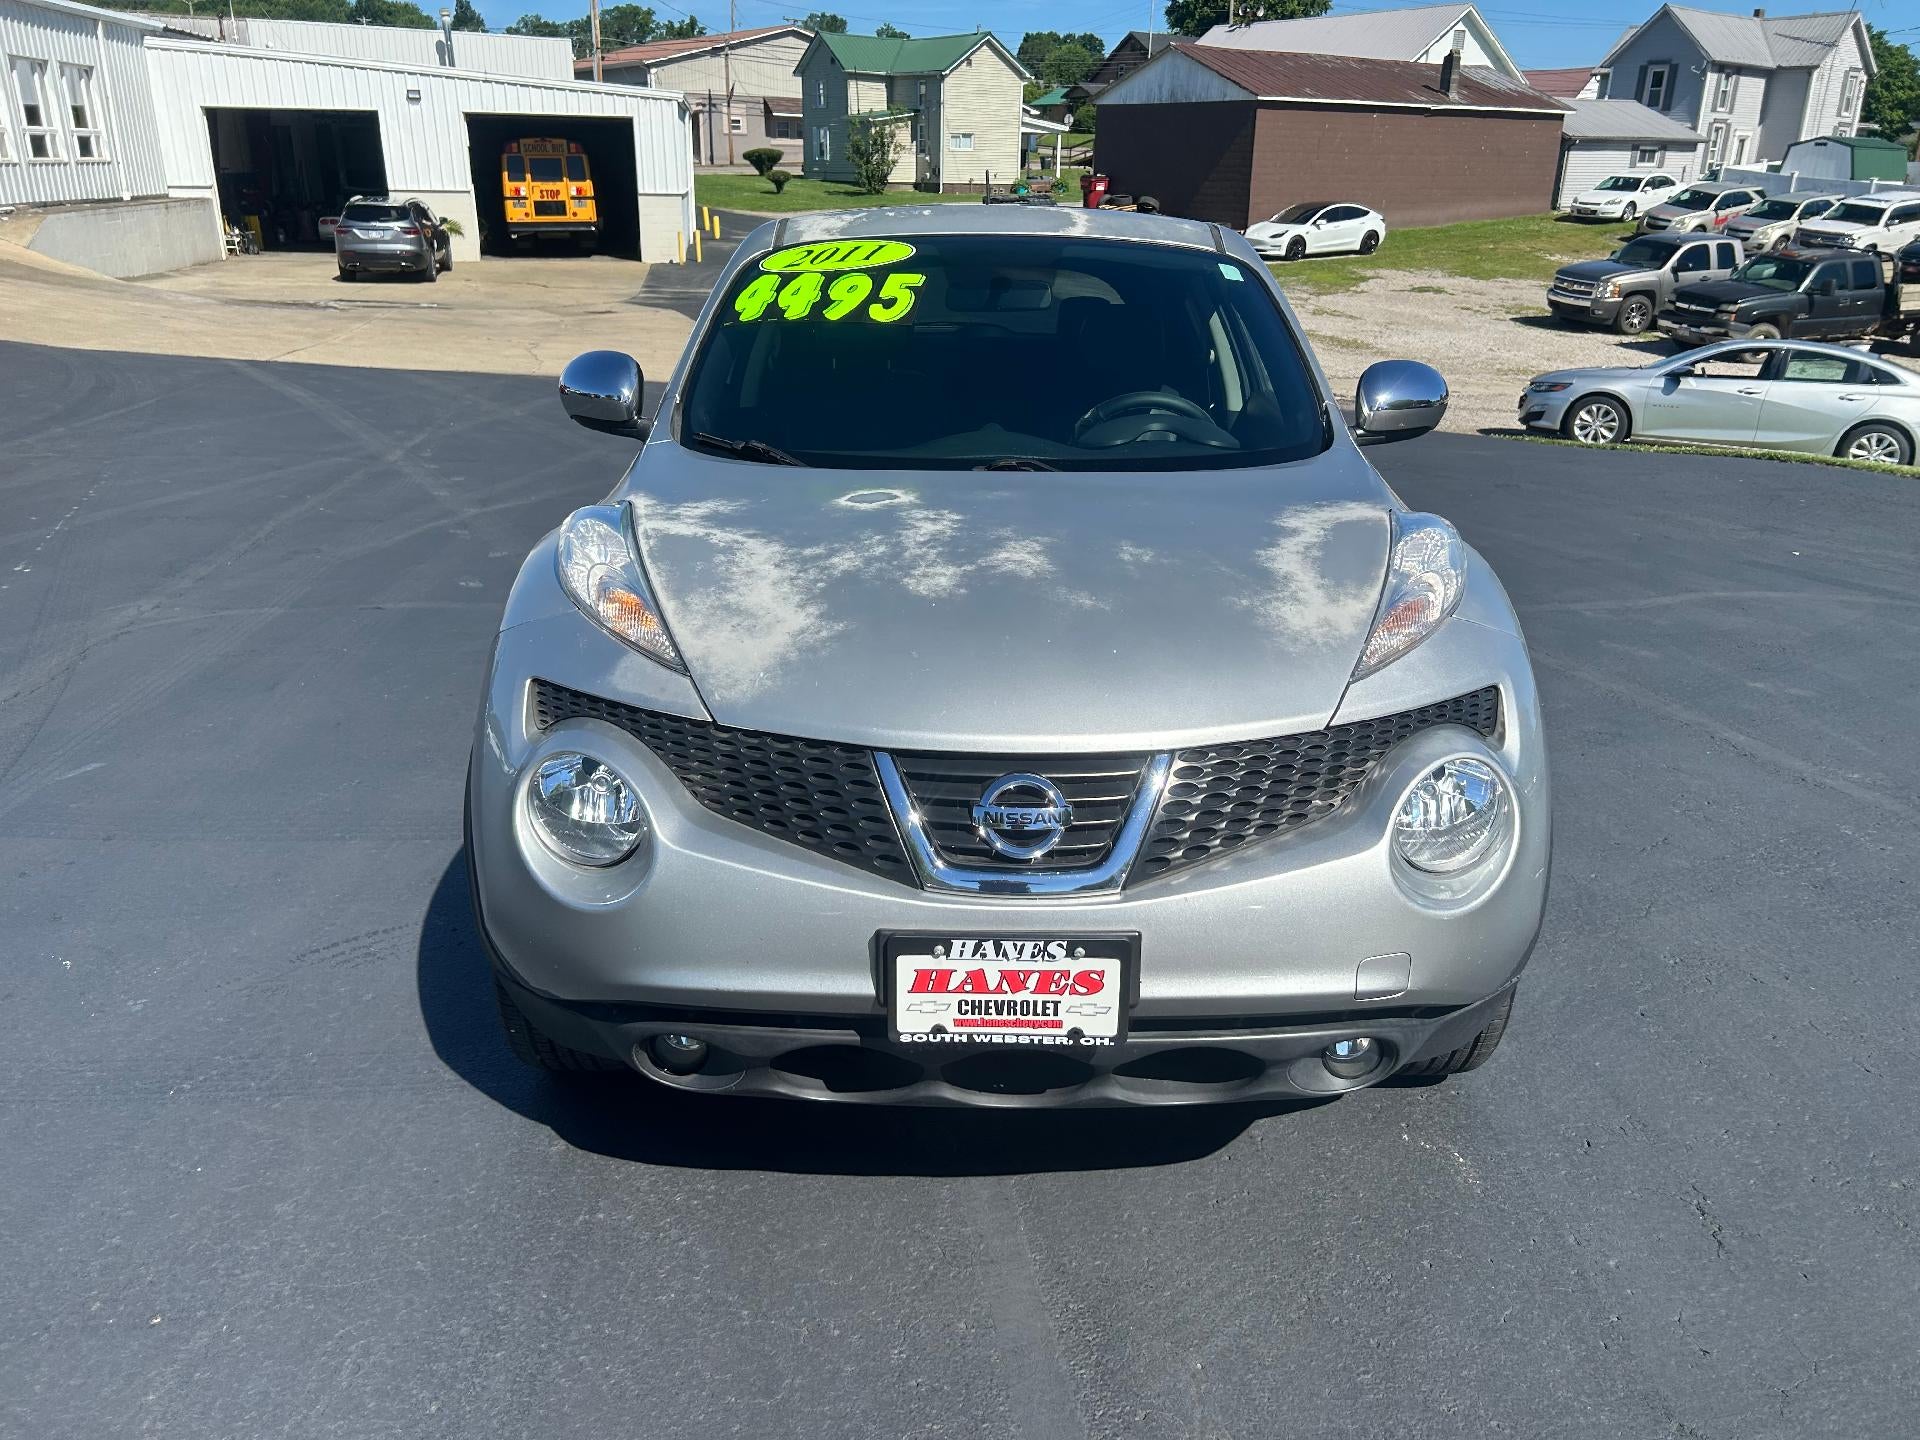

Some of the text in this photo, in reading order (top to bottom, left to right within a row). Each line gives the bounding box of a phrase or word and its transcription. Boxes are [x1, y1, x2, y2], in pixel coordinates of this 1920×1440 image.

[524, 143, 565, 153] SCHOOL BUS
[539, 189, 561, 200] STOP
[783, 244, 889, 269] 2011
[734, 272, 927, 323] 4495
[982, 811, 1061, 825] NISSAN
[946, 939, 1068, 962] HANES
[907, 968, 1105, 996] HANES
[957, 999, 1062, 1017] CHEVROLET
[953, 1017, 1064, 1029] www.haneschevy.com
[899, 1033, 970, 1043] SOUTH
